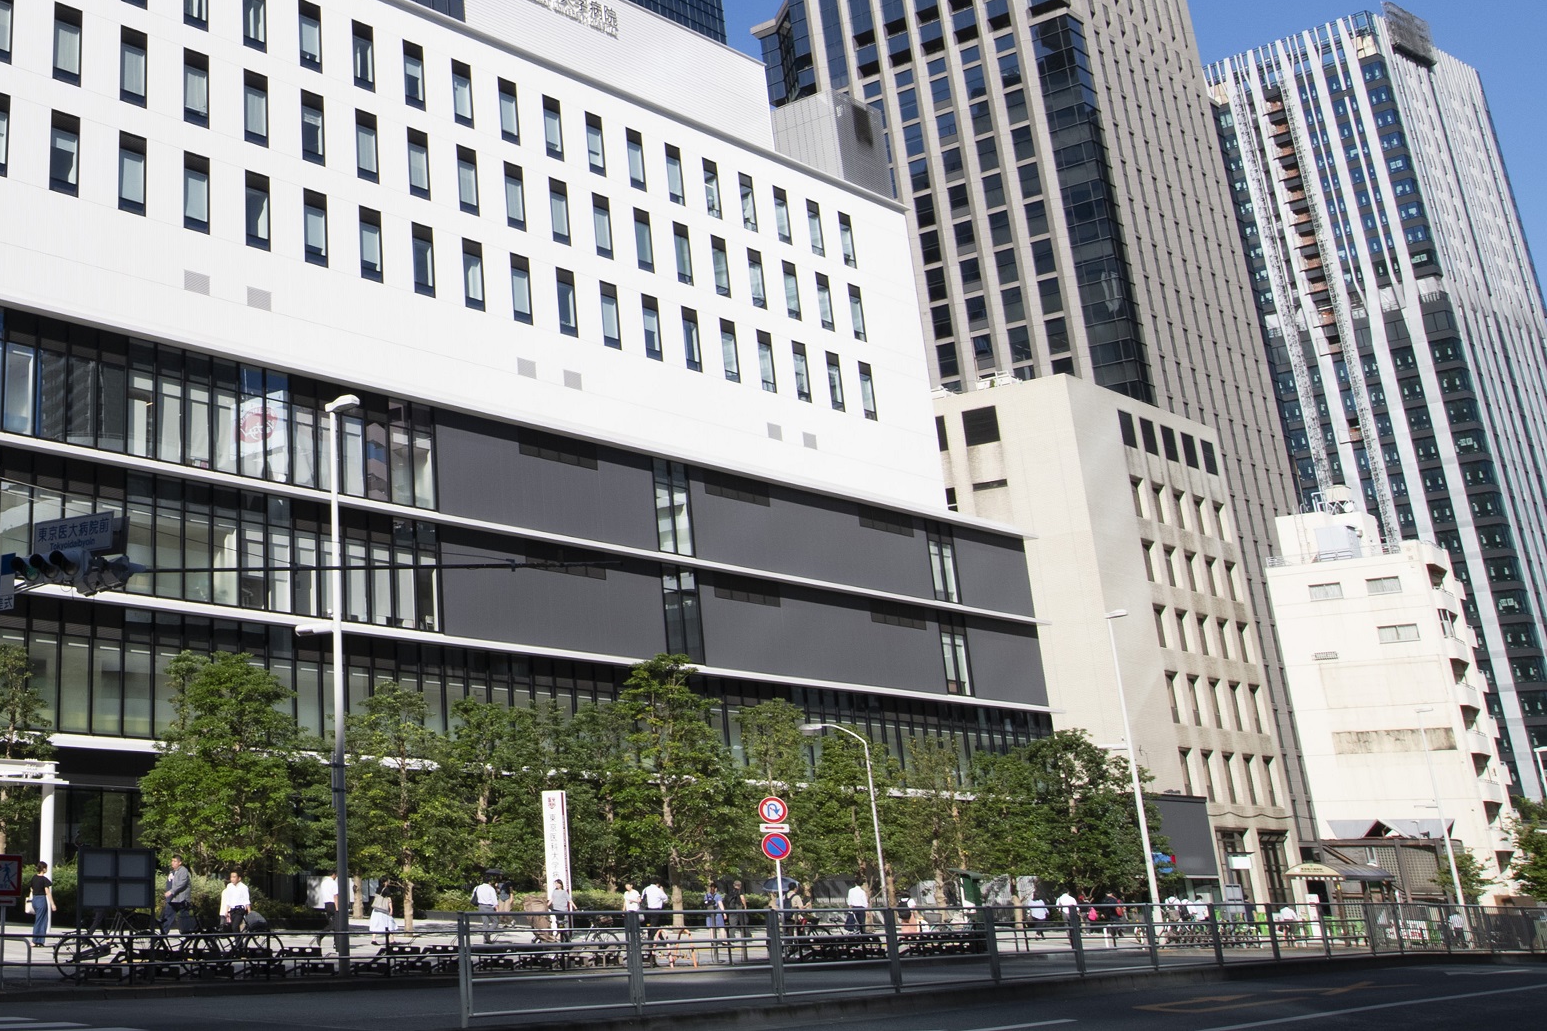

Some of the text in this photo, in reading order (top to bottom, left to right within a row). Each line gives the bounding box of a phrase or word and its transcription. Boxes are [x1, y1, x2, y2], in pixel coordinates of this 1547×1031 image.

[38, 518, 110, 542] 東京医大病院前
